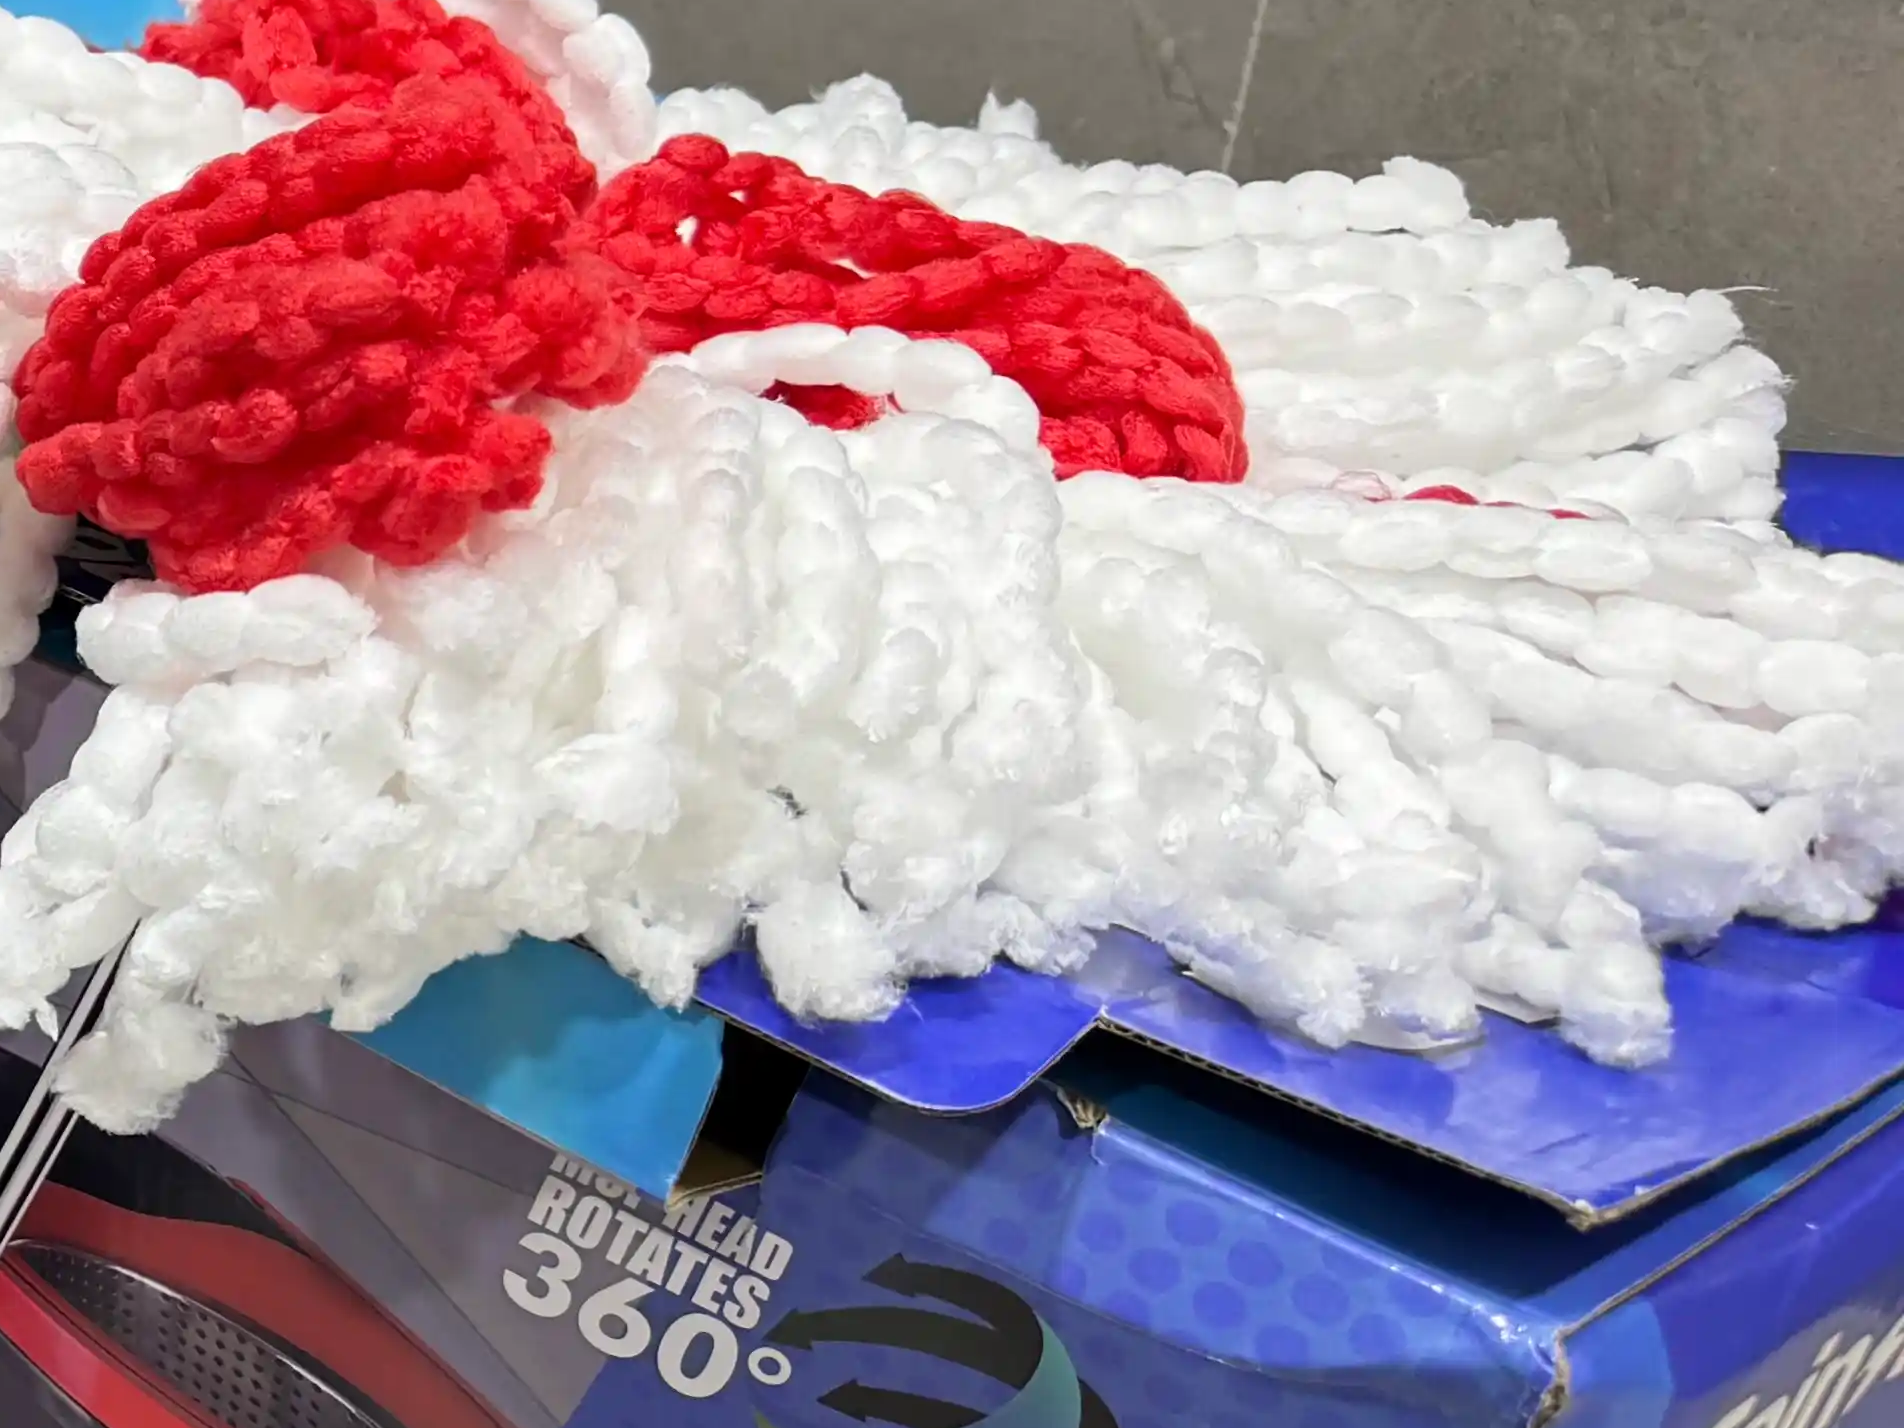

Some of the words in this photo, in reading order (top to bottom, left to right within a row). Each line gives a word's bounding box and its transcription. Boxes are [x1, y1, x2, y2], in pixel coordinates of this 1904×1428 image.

[502, 1232, 792, 1397] 360°
[527, 1174, 771, 1329] ROTATES
[662, 1195, 794, 1280] HEAD
